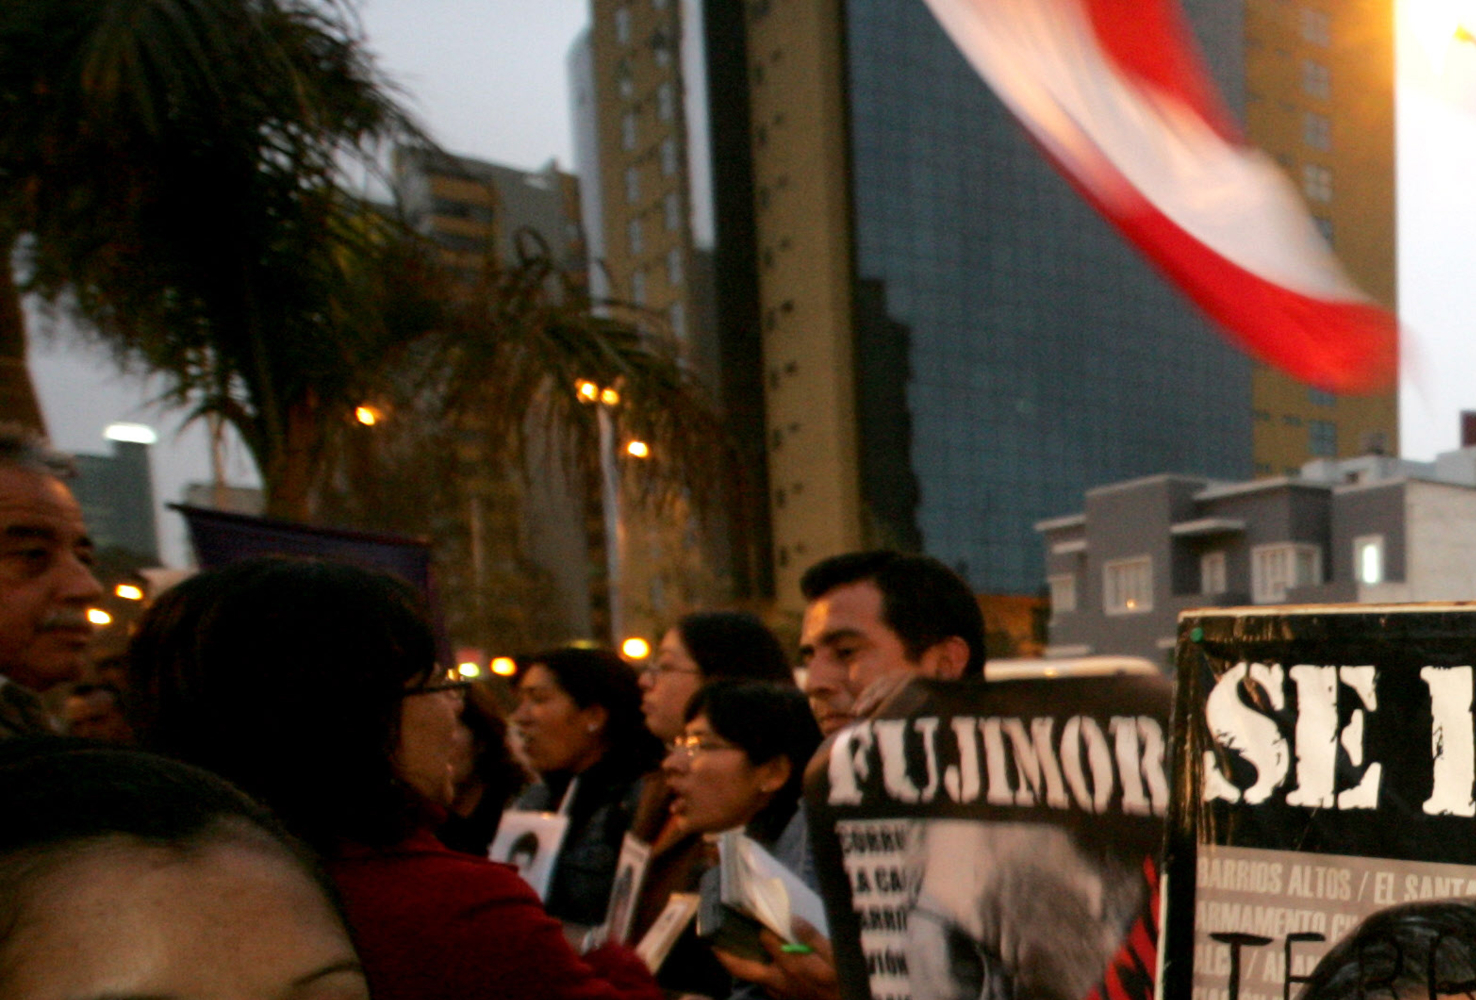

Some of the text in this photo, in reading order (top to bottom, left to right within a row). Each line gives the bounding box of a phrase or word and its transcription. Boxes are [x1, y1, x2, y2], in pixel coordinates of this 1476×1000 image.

[827, 715, 1169, 817] FUJIMOR
[1202, 661, 1383, 810] SE
[1197, 856, 1283, 896] BARRIOS
[1287, 864, 1351, 901] ALTOS
[1374, 871, 1396, 905] EL
